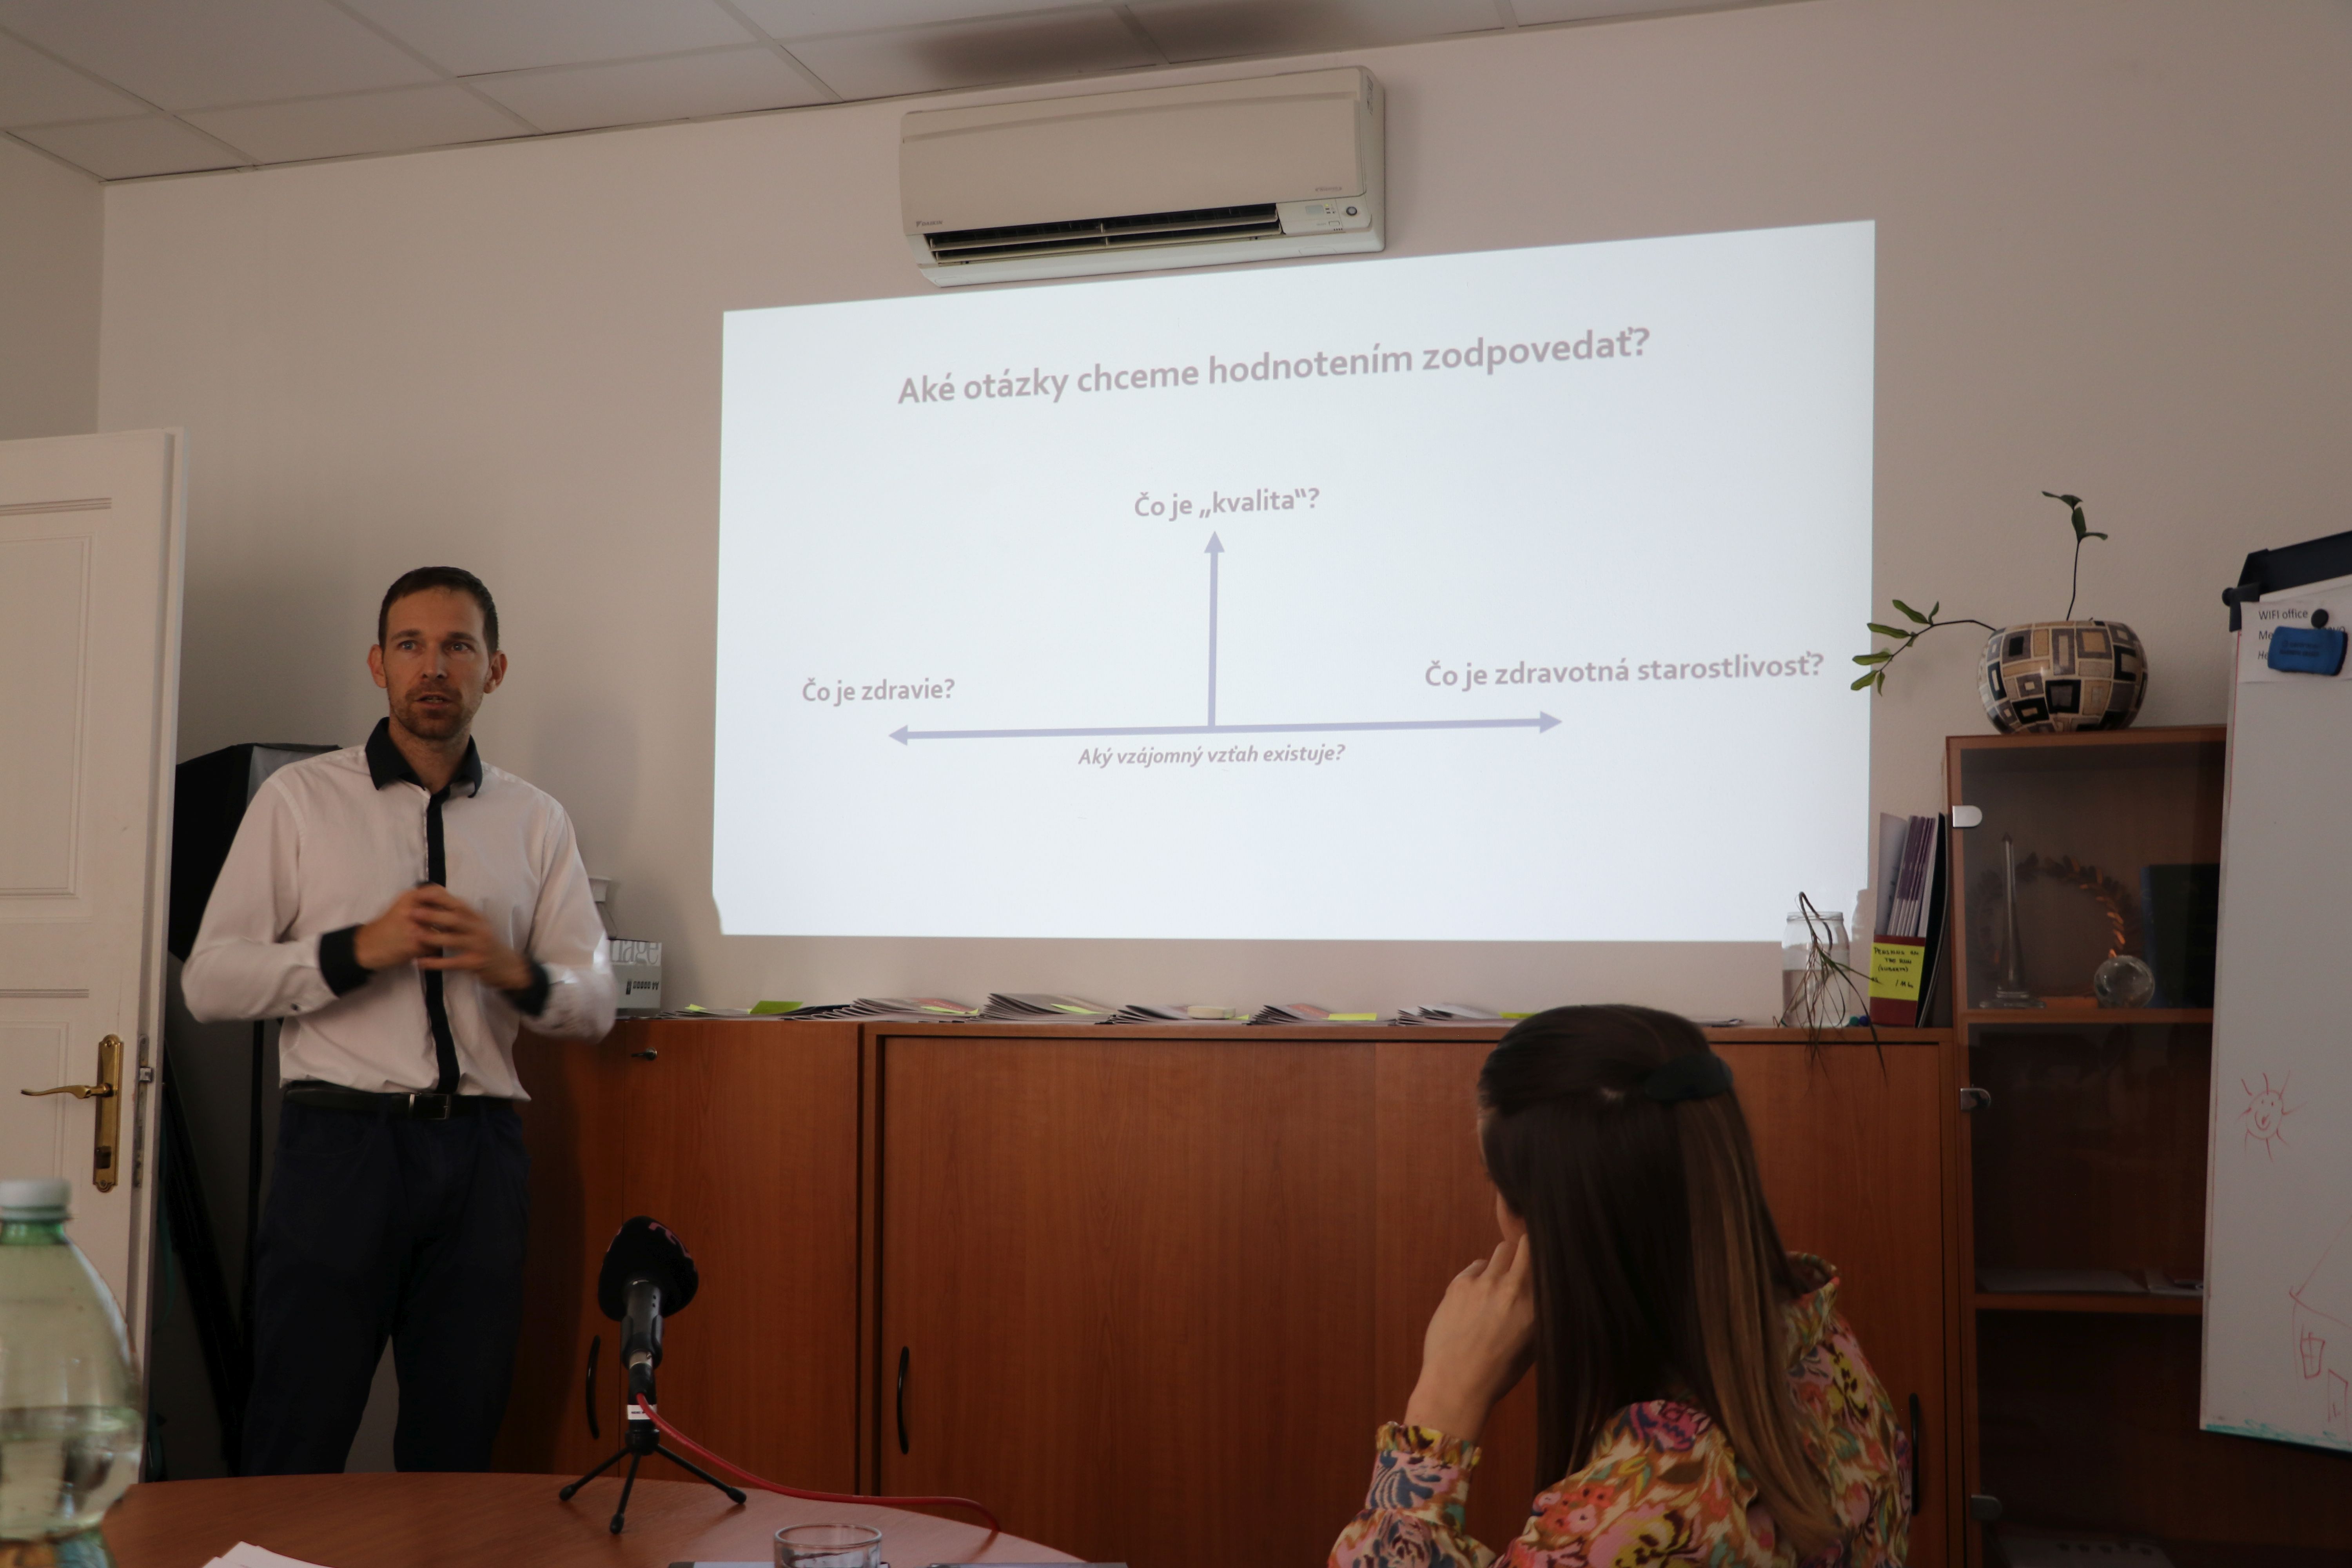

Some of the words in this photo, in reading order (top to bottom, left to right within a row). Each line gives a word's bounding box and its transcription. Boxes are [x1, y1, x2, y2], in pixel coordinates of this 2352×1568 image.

[897, 372, 955, 405] Aké
[963, 367, 1069, 403] otázky
[1077, 363, 1199, 392] chceme
[1209, 342, 1412, 385] hodnotením
[1422, 326, 1650, 376] zodpovedať?
[1134, 491, 1165, 517] Čo
[1168, 492, 1193, 522] je
[2258, 610, 2279, 620] WIFI
[2282, 608, 2308, 619] office
[1425, 660, 1458, 687] Čo
[1461, 662, 1488, 692] je
[1495, 657, 1629, 685] zdravotná
[1637, 650, 1824, 681] starostlivosť?
[802, 677, 831, 702] Čo
[833, 679, 856, 708] je
[861, 677, 955, 701] zdravie?
[1078, 747, 1113, 769] Aký
[1117, 746, 1204, 768] vzájomný
[1207, 744, 1259, 763] vzťah
[1263, 743, 1346, 766] existuje?
